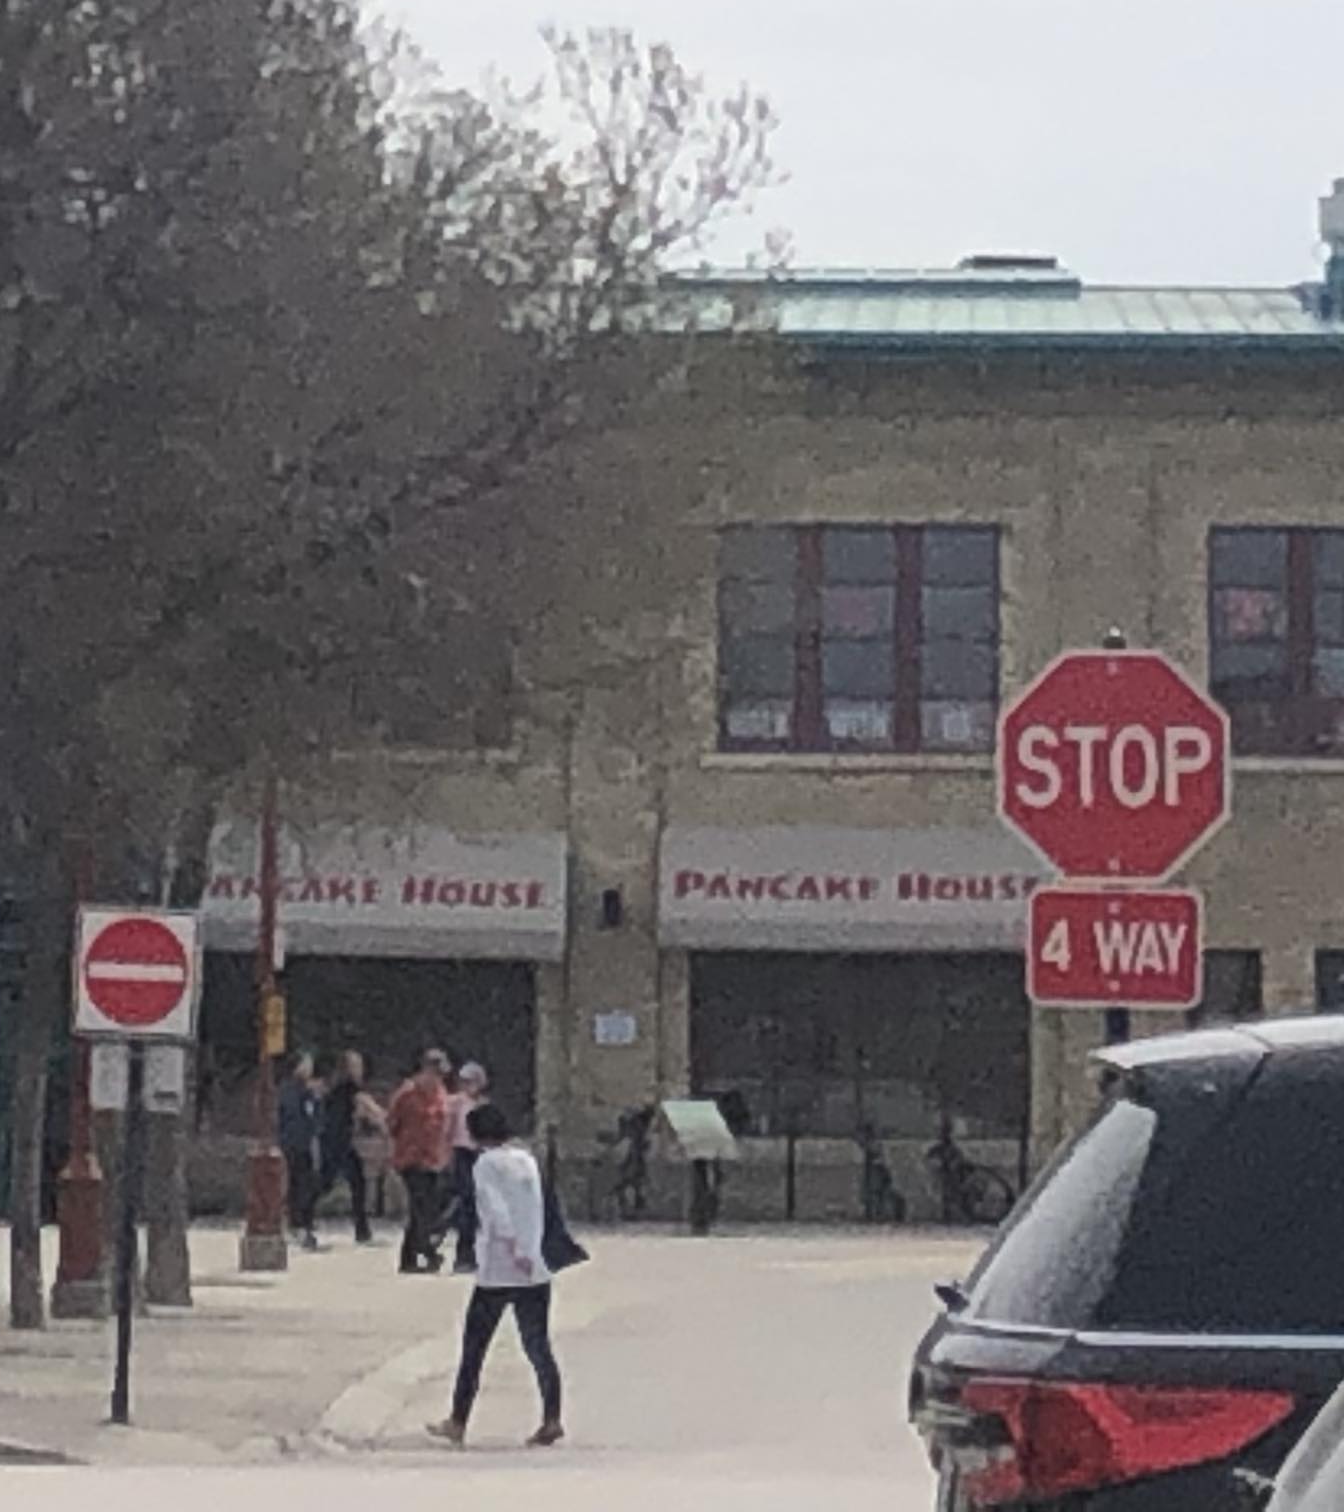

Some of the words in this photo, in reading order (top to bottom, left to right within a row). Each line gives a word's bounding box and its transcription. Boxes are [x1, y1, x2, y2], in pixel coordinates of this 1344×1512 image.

[1015, 724, 1212, 808] STOP
[206, 873, 380, 904] ANCAKE
[402, 874, 542, 909] HOUSE
[673, 870, 879, 901] PANCAKE
[1041, 918, 1071, 972] 4
[1093, 919, 1188, 975] WAY
